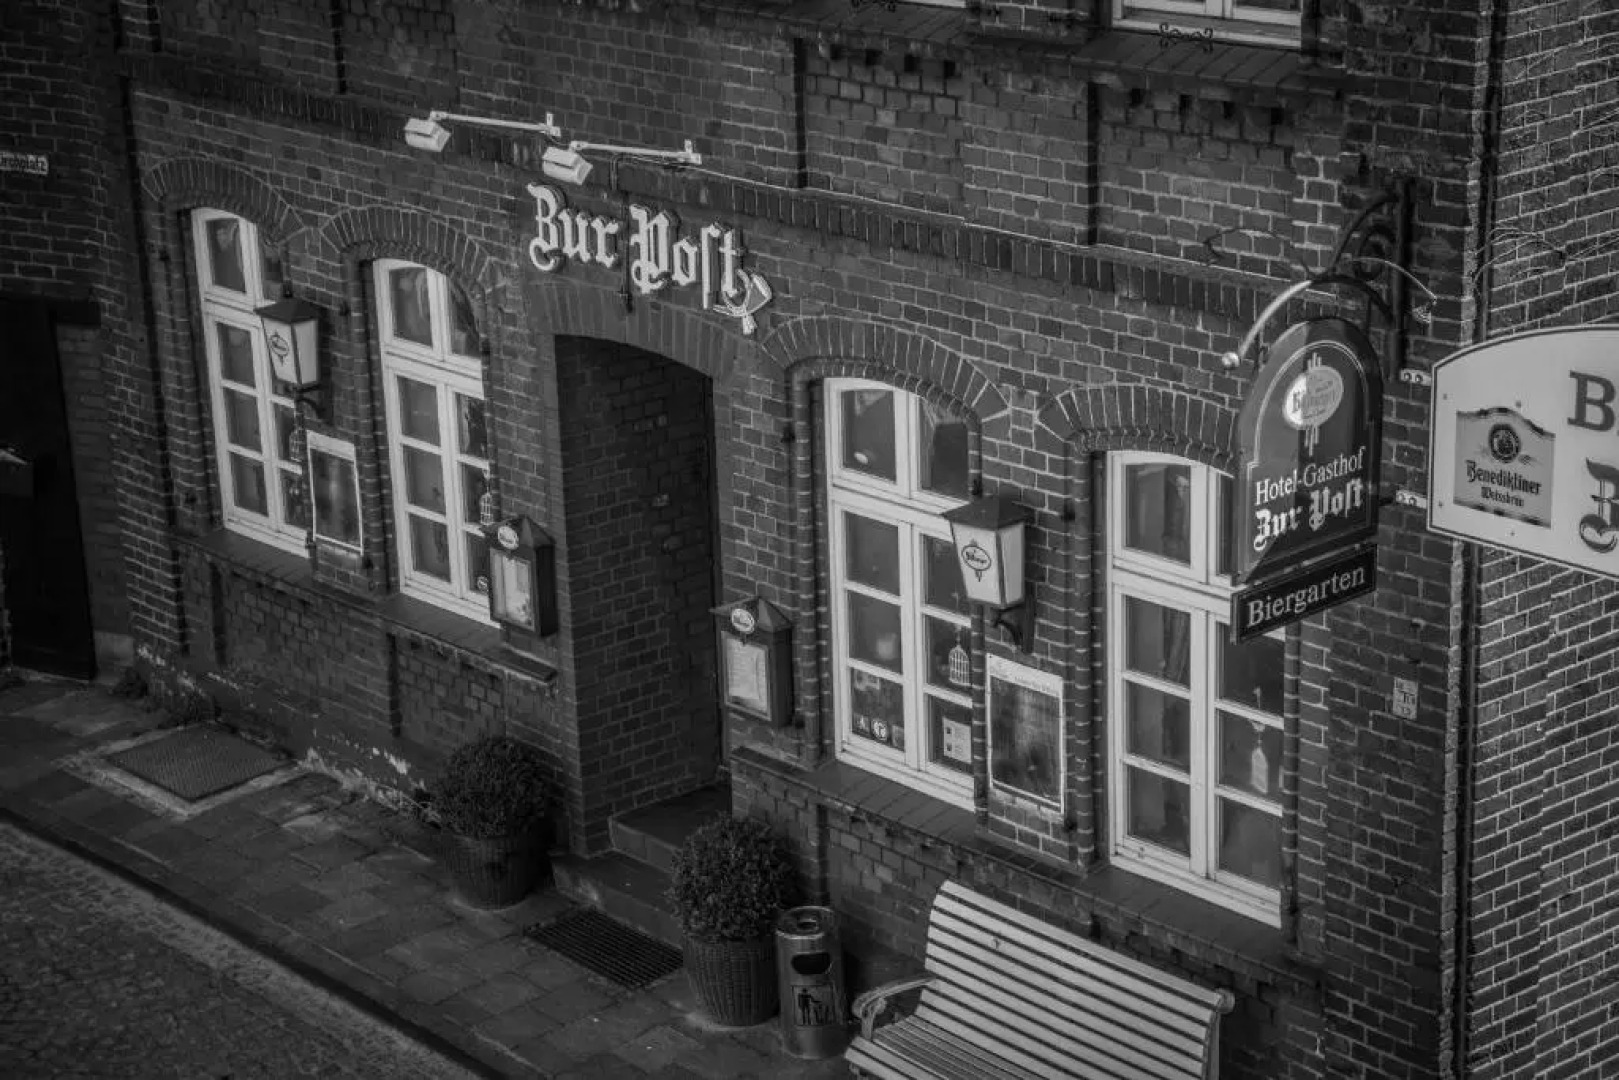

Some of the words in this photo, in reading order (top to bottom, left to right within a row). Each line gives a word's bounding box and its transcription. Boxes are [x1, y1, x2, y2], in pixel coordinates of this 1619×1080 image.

[1567, 369, 1619, 433] B
[1255, 446, 1366, 506] Hotel-Gasthof
[1248, 566, 1366, 627] Biergarten
